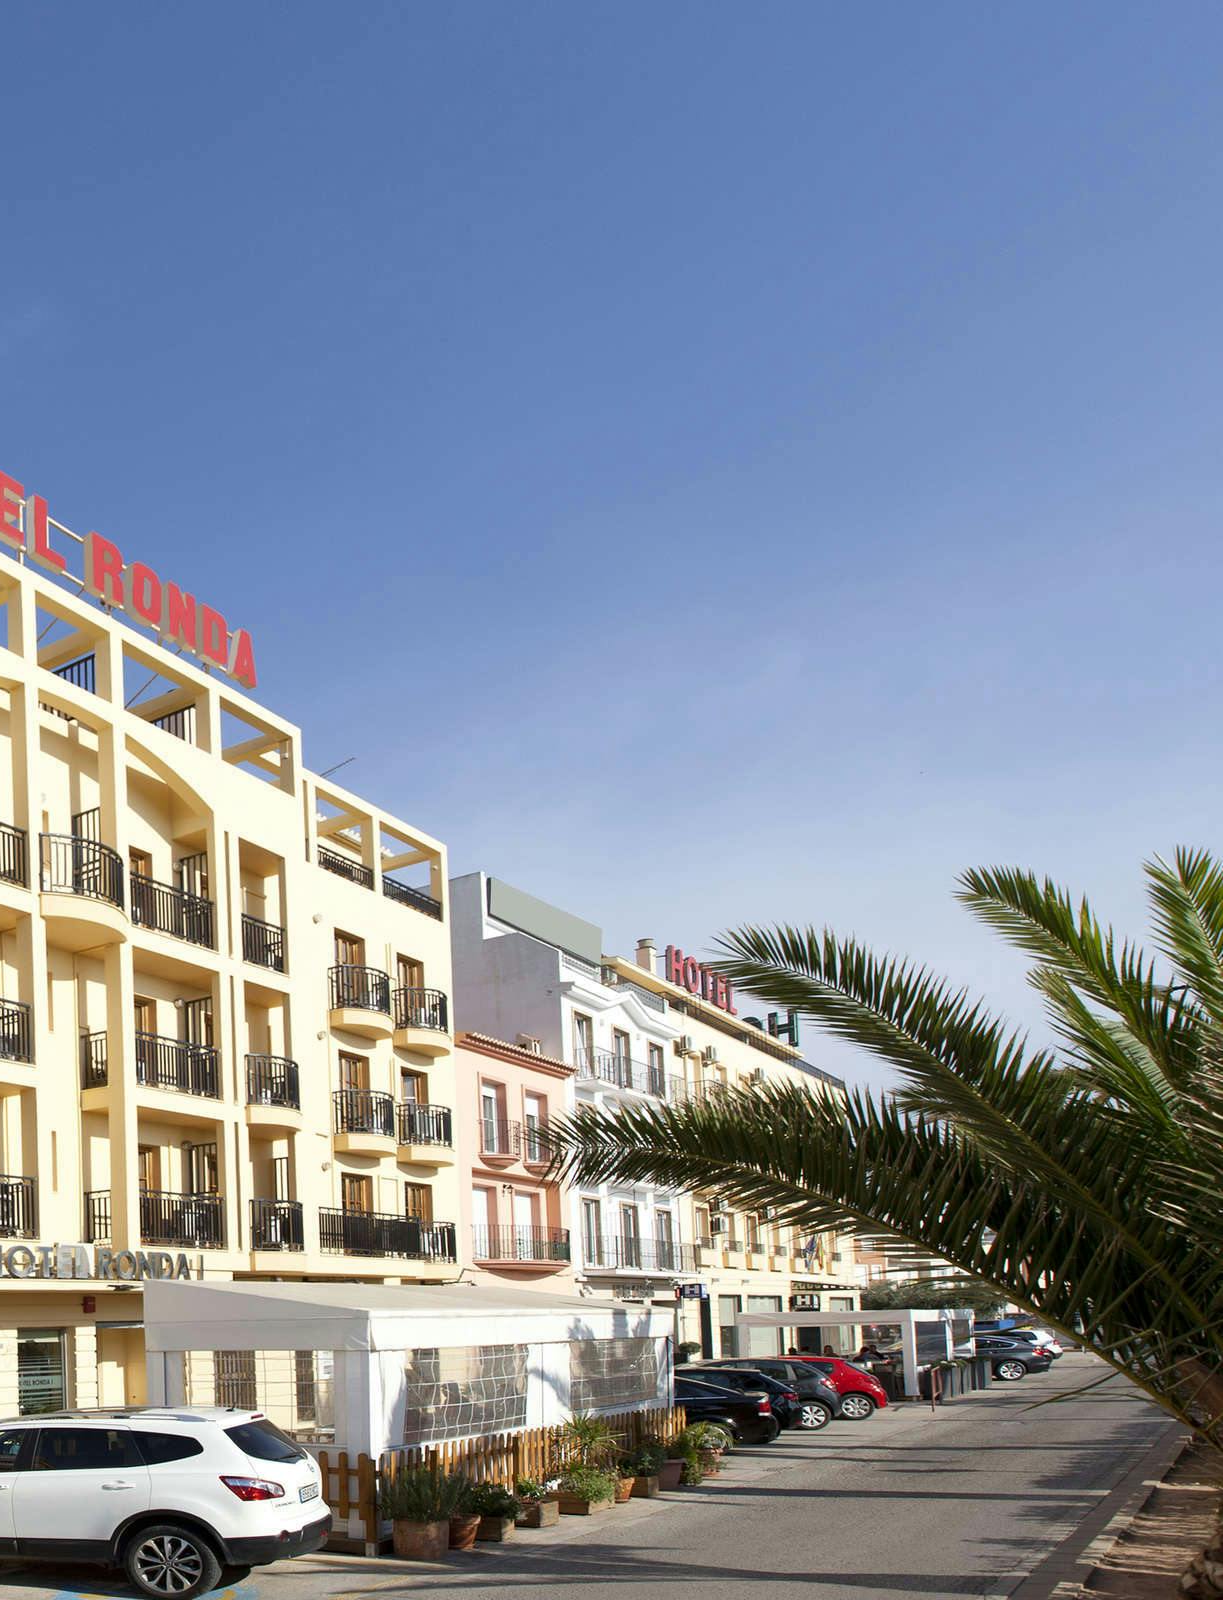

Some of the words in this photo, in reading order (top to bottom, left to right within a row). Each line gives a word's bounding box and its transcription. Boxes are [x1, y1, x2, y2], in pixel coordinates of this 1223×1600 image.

[83, 531, 256, 688] RONDA
[665, 944, 738, 1015] HOTEL
[97, 1247, 191, 1280] RONDA
